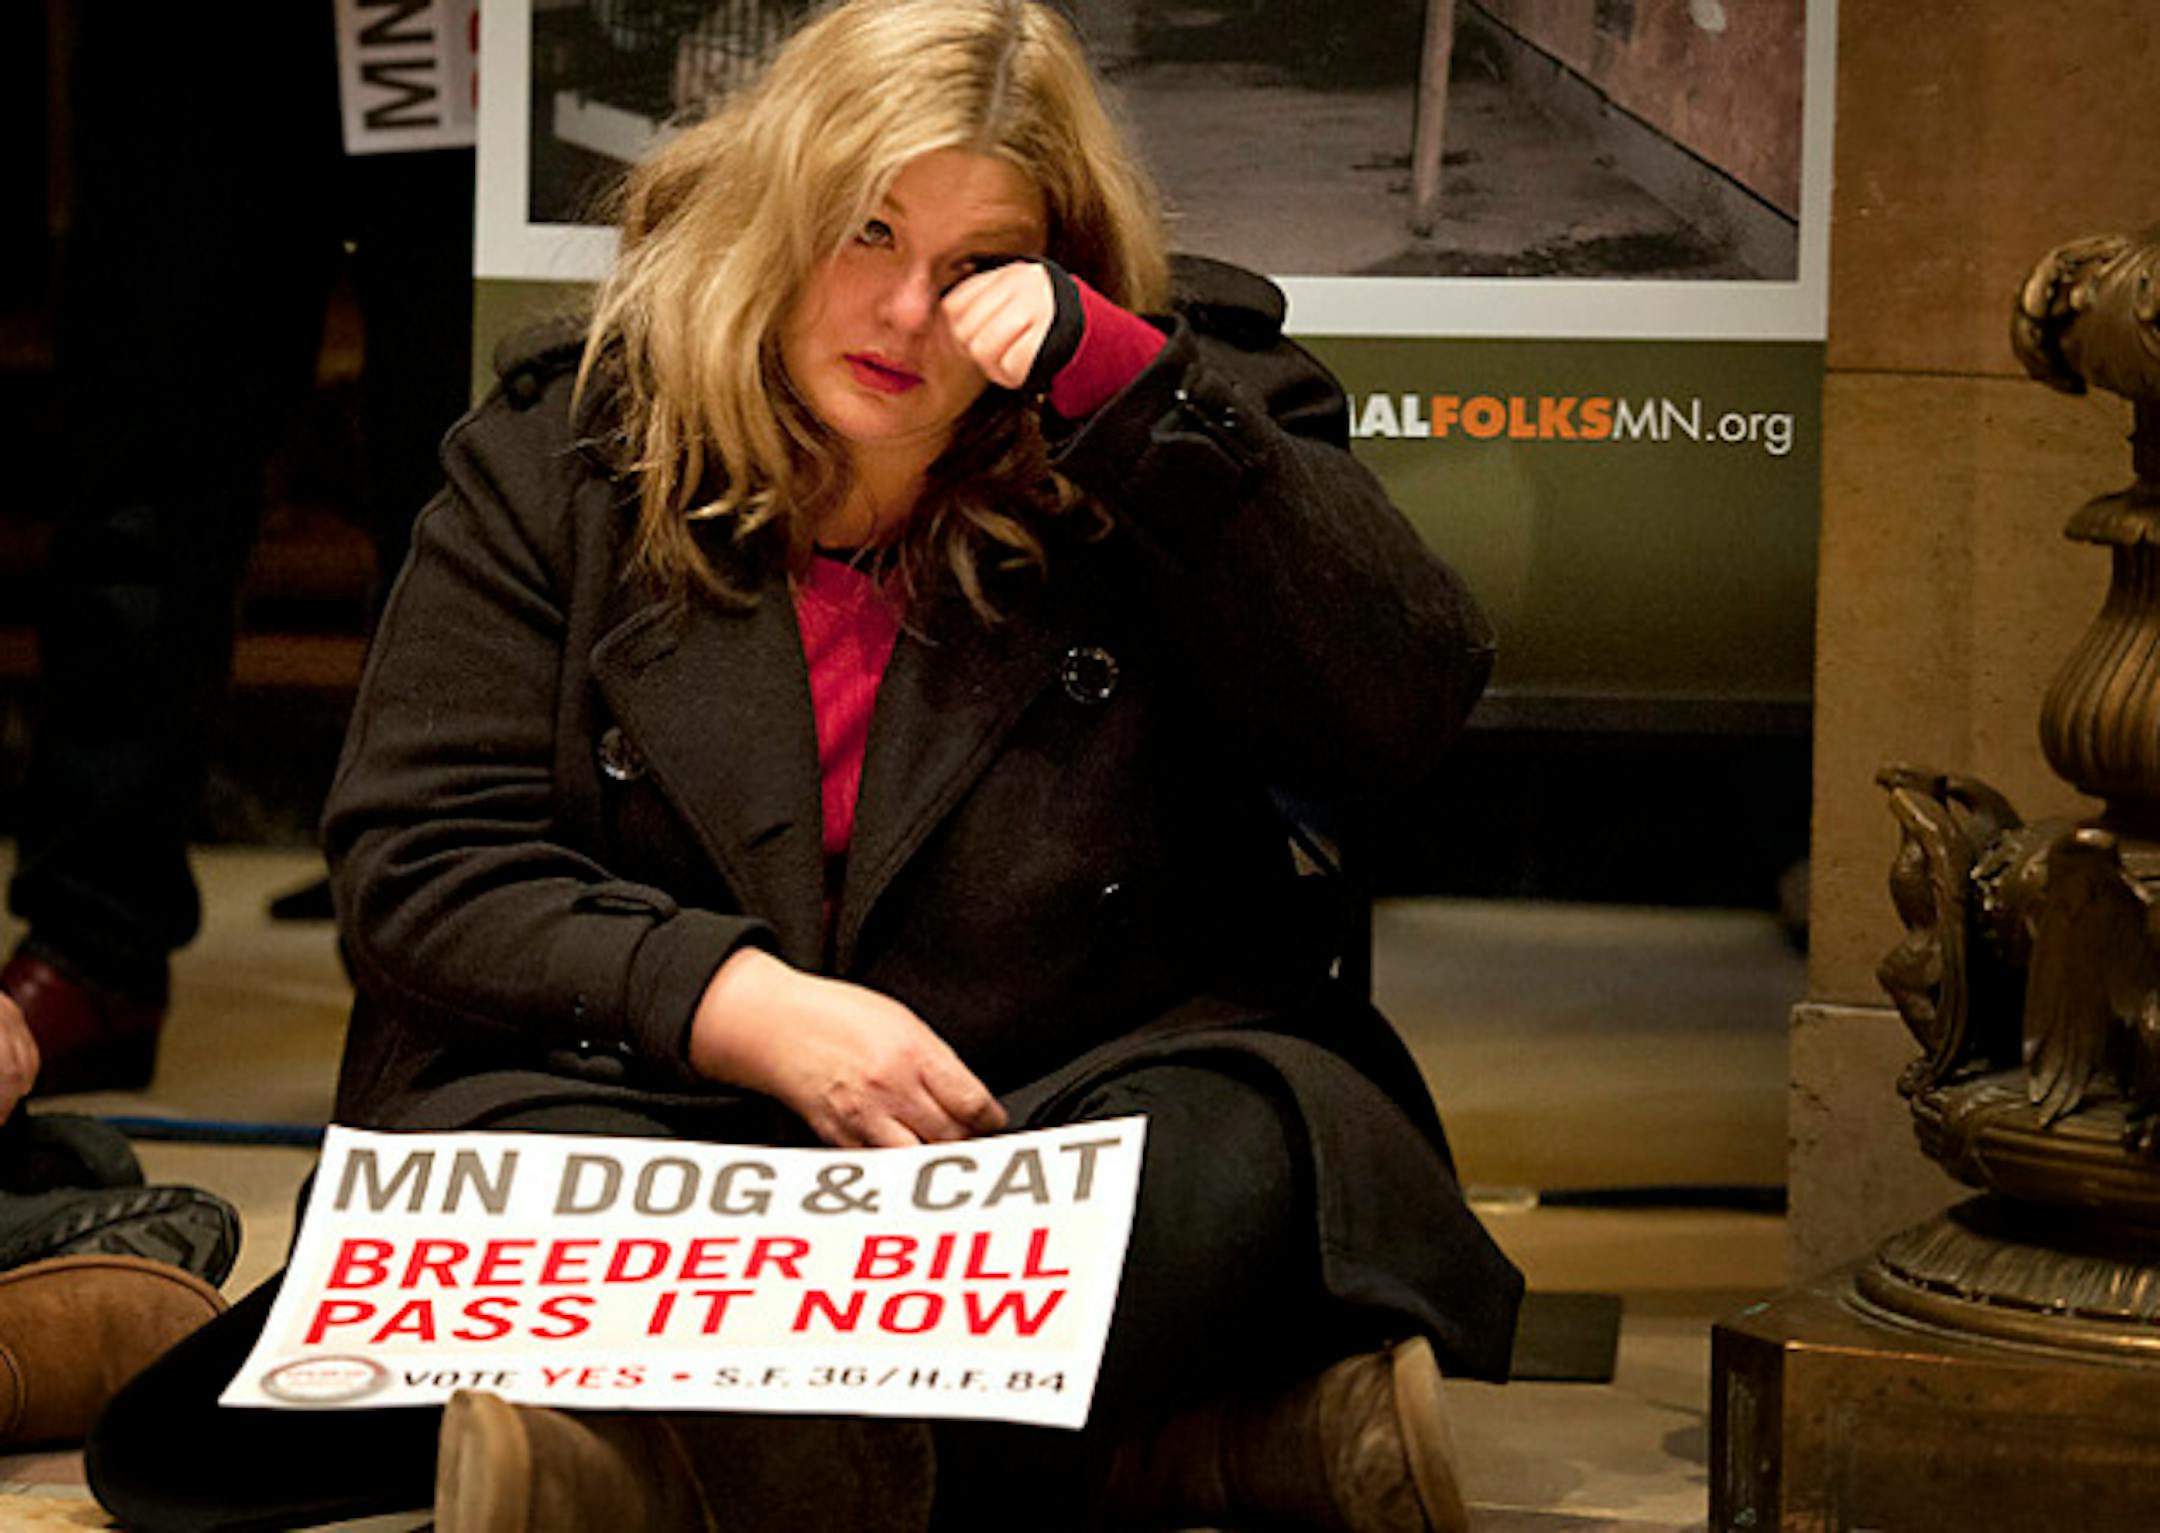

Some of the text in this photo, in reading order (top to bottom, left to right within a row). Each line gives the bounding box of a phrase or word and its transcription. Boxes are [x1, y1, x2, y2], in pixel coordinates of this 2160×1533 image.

[333, 1136, 1123, 1217] MN DOG & CAT
[325, 1225, 1072, 1290] BREEDER BILL
[302, 1288, 1067, 1345] PASS IT NOW
[403, 1370, 519, 1389] VOTE
[540, 1365, 646, 1390] YES
[712, 1366, 793, 1390] S.F.
[1005, 1371, 1066, 1395] 84
